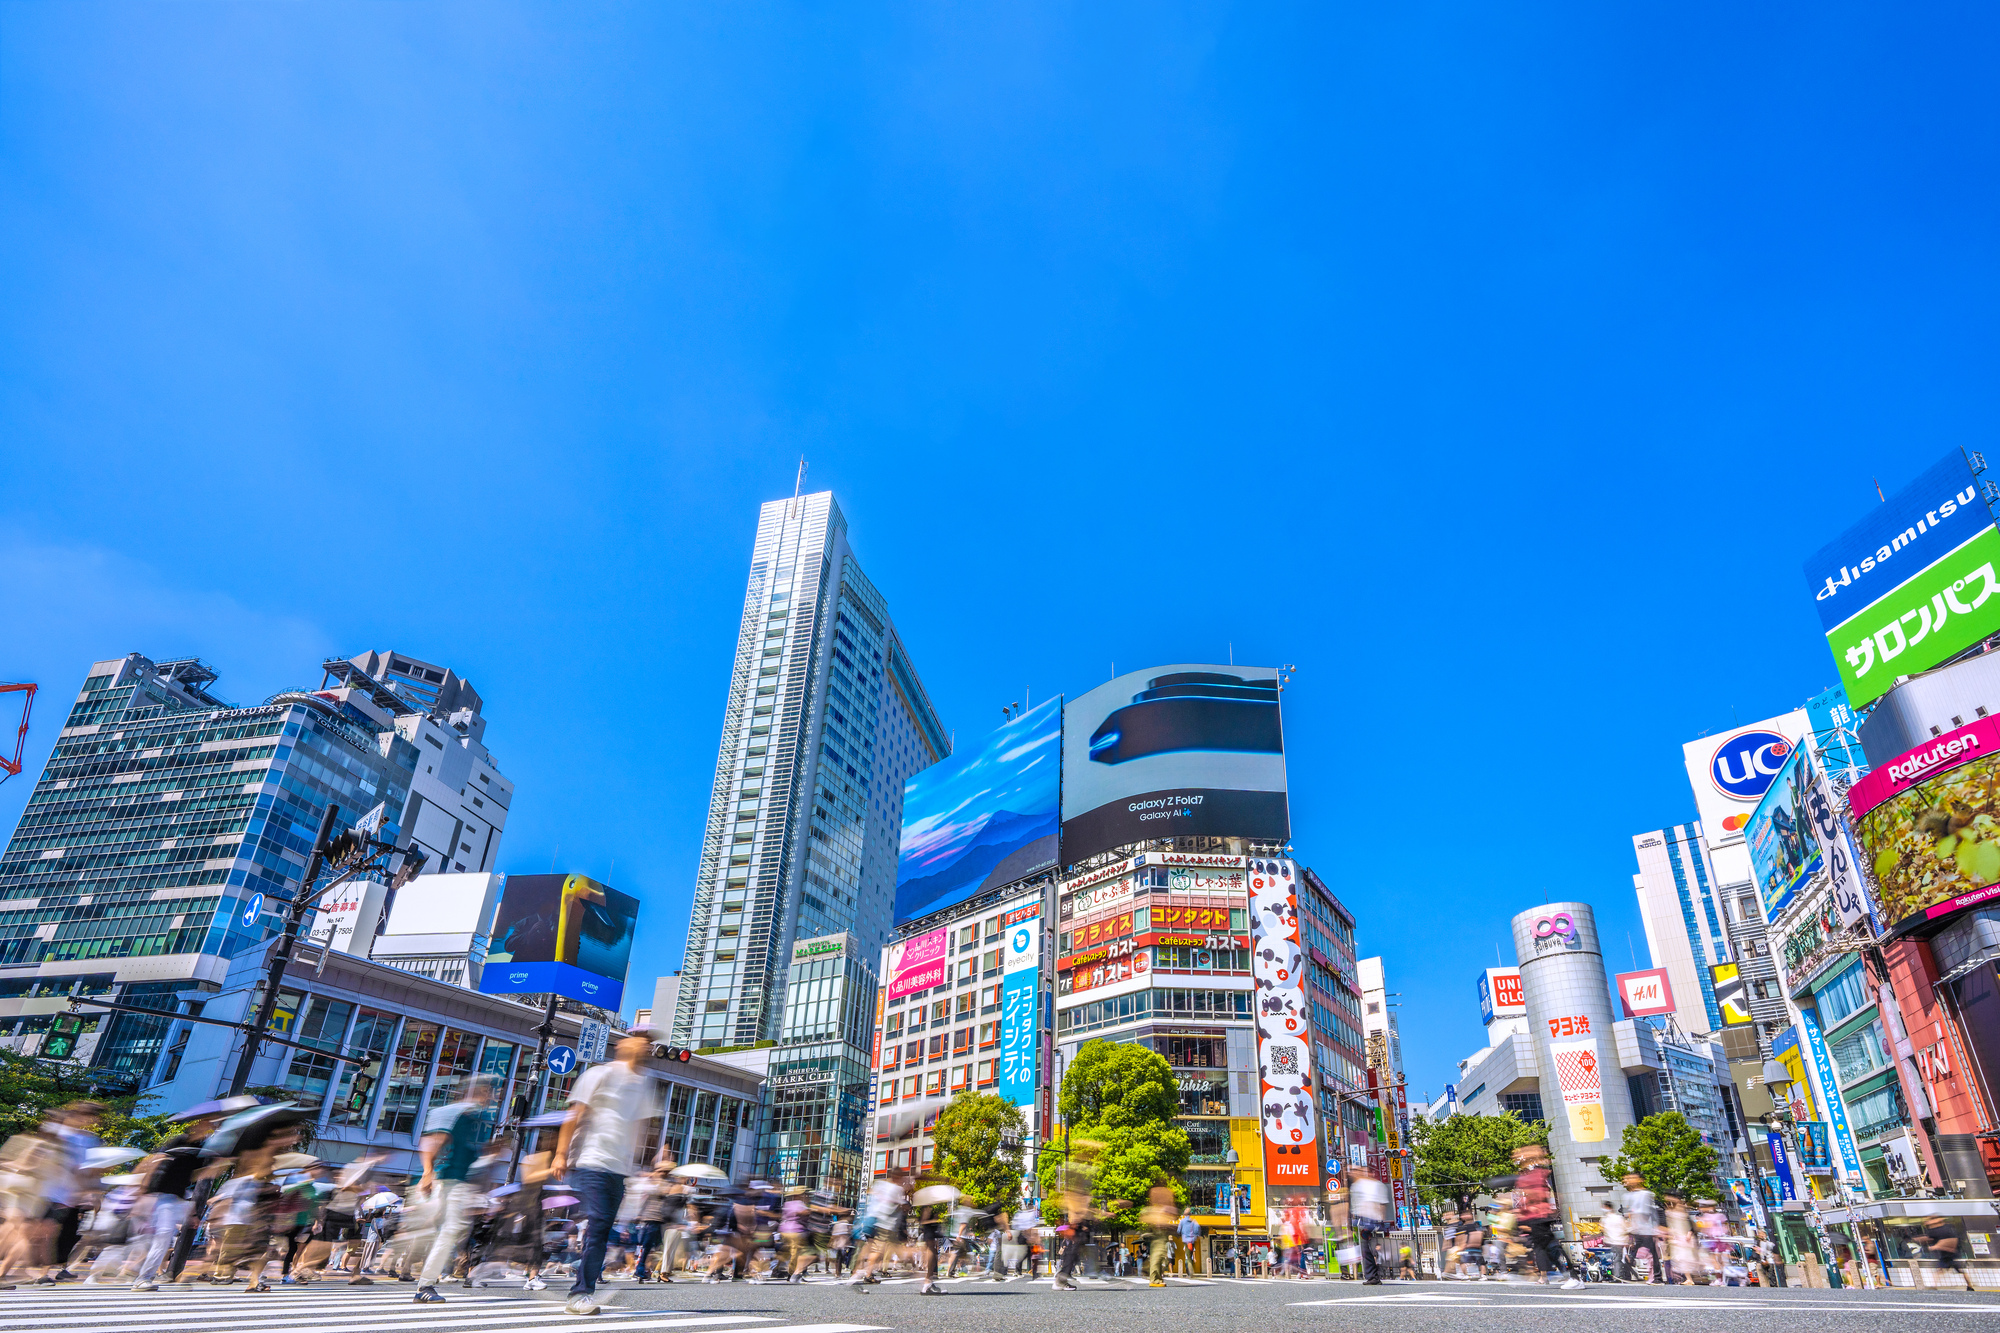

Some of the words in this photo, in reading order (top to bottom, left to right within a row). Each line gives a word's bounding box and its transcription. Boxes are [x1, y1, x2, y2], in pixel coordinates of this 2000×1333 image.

[1816, 485, 1976, 601] Hisamitsu
[1845, 561, 2000, 679] サロンパス
[1813, 688, 1846, 710] のど、直
[222, 705, 284, 718] FUKURAS
[1888, 733, 1979, 783] Rakuten
[1128, 798, 1166, 812] Galaxy
[1167, 797, 1174, 806] Z
[1175, 796, 1204, 805] Fold7
[1139, 811, 1171, 821] Galaxy
[1637, 840, 1662, 849] INDIGO
[1810, 785, 1862, 914] もんじゃ
[1161, 853, 1242, 866] しゃぶしゃぶバイキング
[1066, 861, 1128, 891] しゃぶしゃぶバイキング
[1195, 872, 1242, 889] しゃぶ葉
[1094, 879, 1130, 904] しゃぶ葉
[1955, 891, 1986, 907] Rakuten
[322, 901, 359, 914] 広告募集
[1061, 902, 1073, 914] 9F
[1151, 908, 1227, 925] コンタクト
[1074, 914, 1132, 945] プライス
[1526, 912, 1576, 943] 109
[796, 945, 820, 956] MARK
[820, 942, 842, 951] CITY
[914, 934, 944, 951] 品川スキン
[1108, 938, 1139, 959] ガスト
[1205, 935, 1242, 950] ガスト
[914, 946, 940, 961] クリニック
[1007, 953, 1034, 967] eyecity
[509, 971, 529, 980] prime
[896, 968, 942, 993] 品川美容外科
[1092, 960, 1130, 988] ガスト
[581, 981, 599, 991] prime
[1060, 979, 1073, 991] 7F
[1633, 984, 1657, 1002] H&M
[1019, 985, 1033, 1083] コンタクトの
[1548, 1015, 1591, 1038] マヨ渋
[583, 1022, 598, 1060] 渋谷駅前
[1004, 988, 1021, 1085] アイシティ
[772, 1073, 805, 1085] MARK
[808, 1070, 837, 1081] CITY
[789, 1066, 819, 1075] SHIBUYA
[1808, 1028, 1842, 1121] サマーフルーツギフト
[1773, 1139, 1784, 1164] MIZUHO
